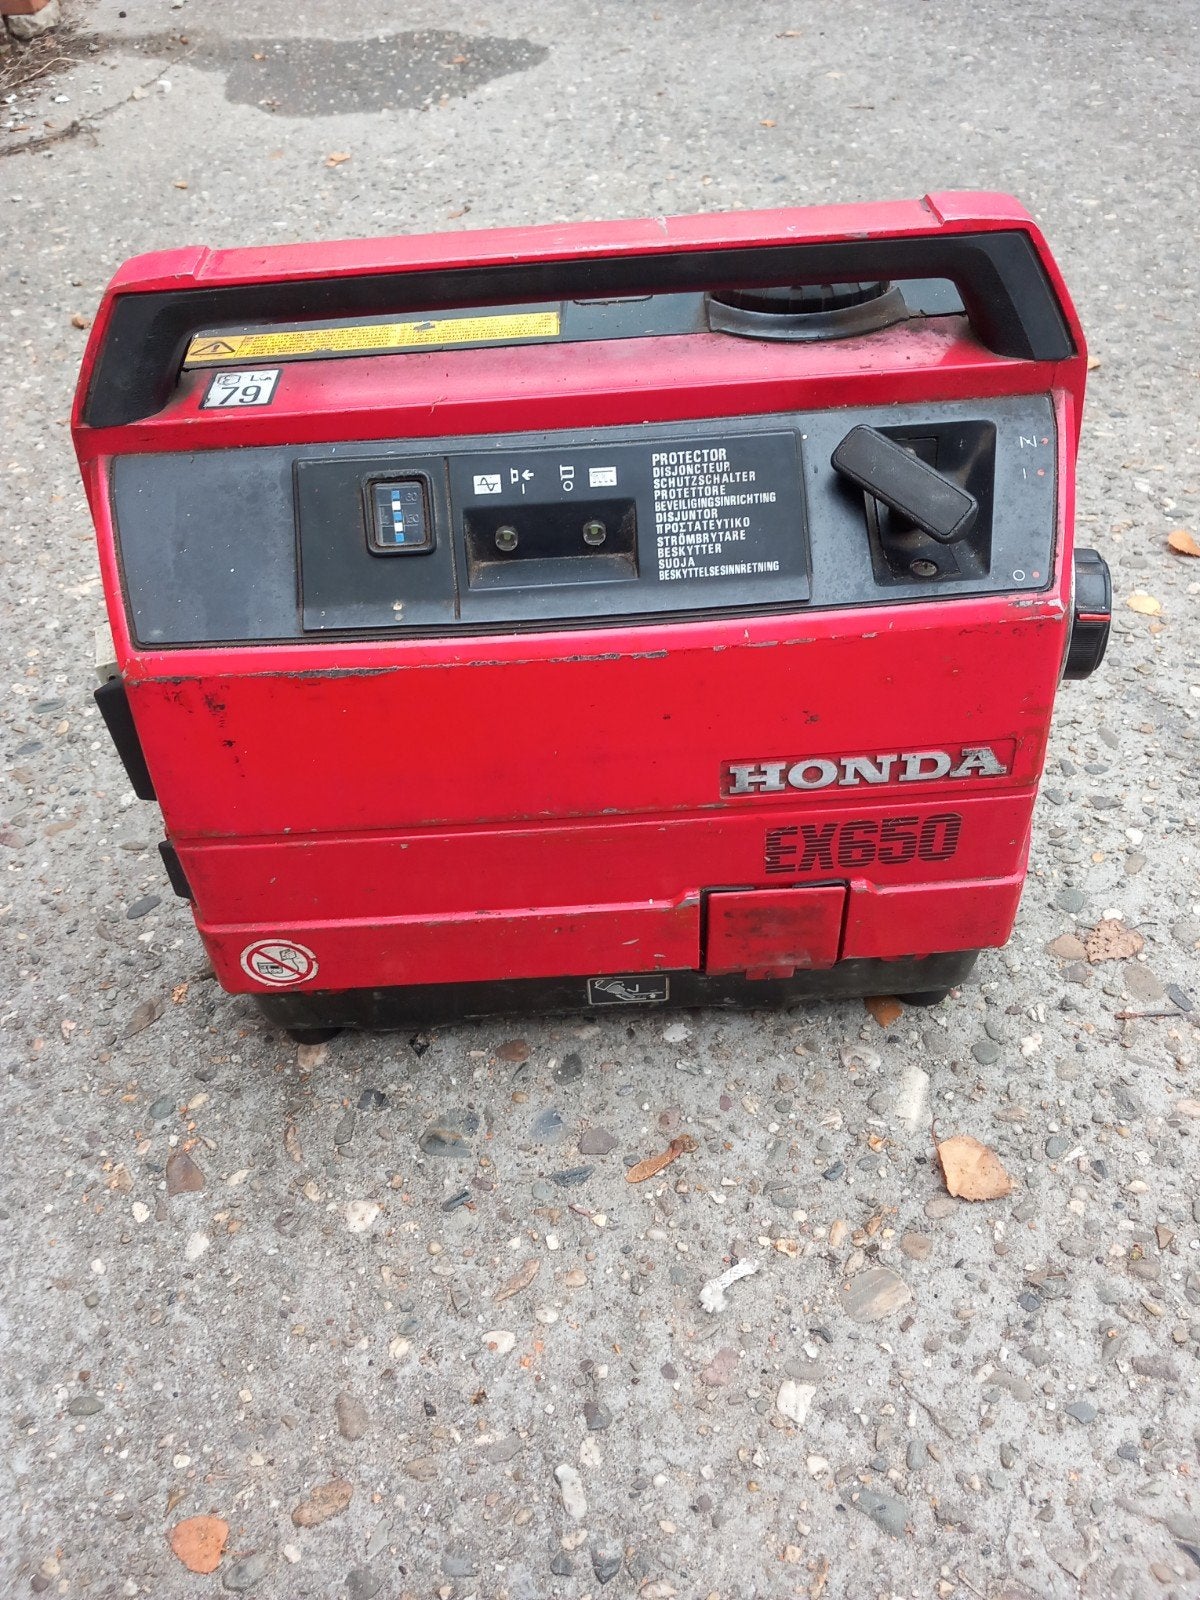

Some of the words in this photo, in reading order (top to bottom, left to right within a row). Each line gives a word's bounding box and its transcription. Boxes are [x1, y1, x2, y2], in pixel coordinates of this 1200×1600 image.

[218, 385, 262, 405] 79
[652, 448, 727, 466] PROTECTOR
[653, 462, 731, 478] DISJONCTEUR
[653, 471, 756, 489] SCHUTZSCHALTER
[654, 485, 726, 500] PROTETTORE
[655, 492, 776, 512] BEVEILIGINGSINRICHTING
[655, 508, 718, 523] DISJUNTOR
[657, 530, 746, 547] STRÖMBRYTARE
[657, 543, 722, 558] BESKYTTER
[658, 557, 695, 570] SUOJA
[659, 561, 780, 581] BESKYTTELSESINNRETNING
[729, 746, 1008, 794] HONDA
[765, 812, 963, 874] EX650
